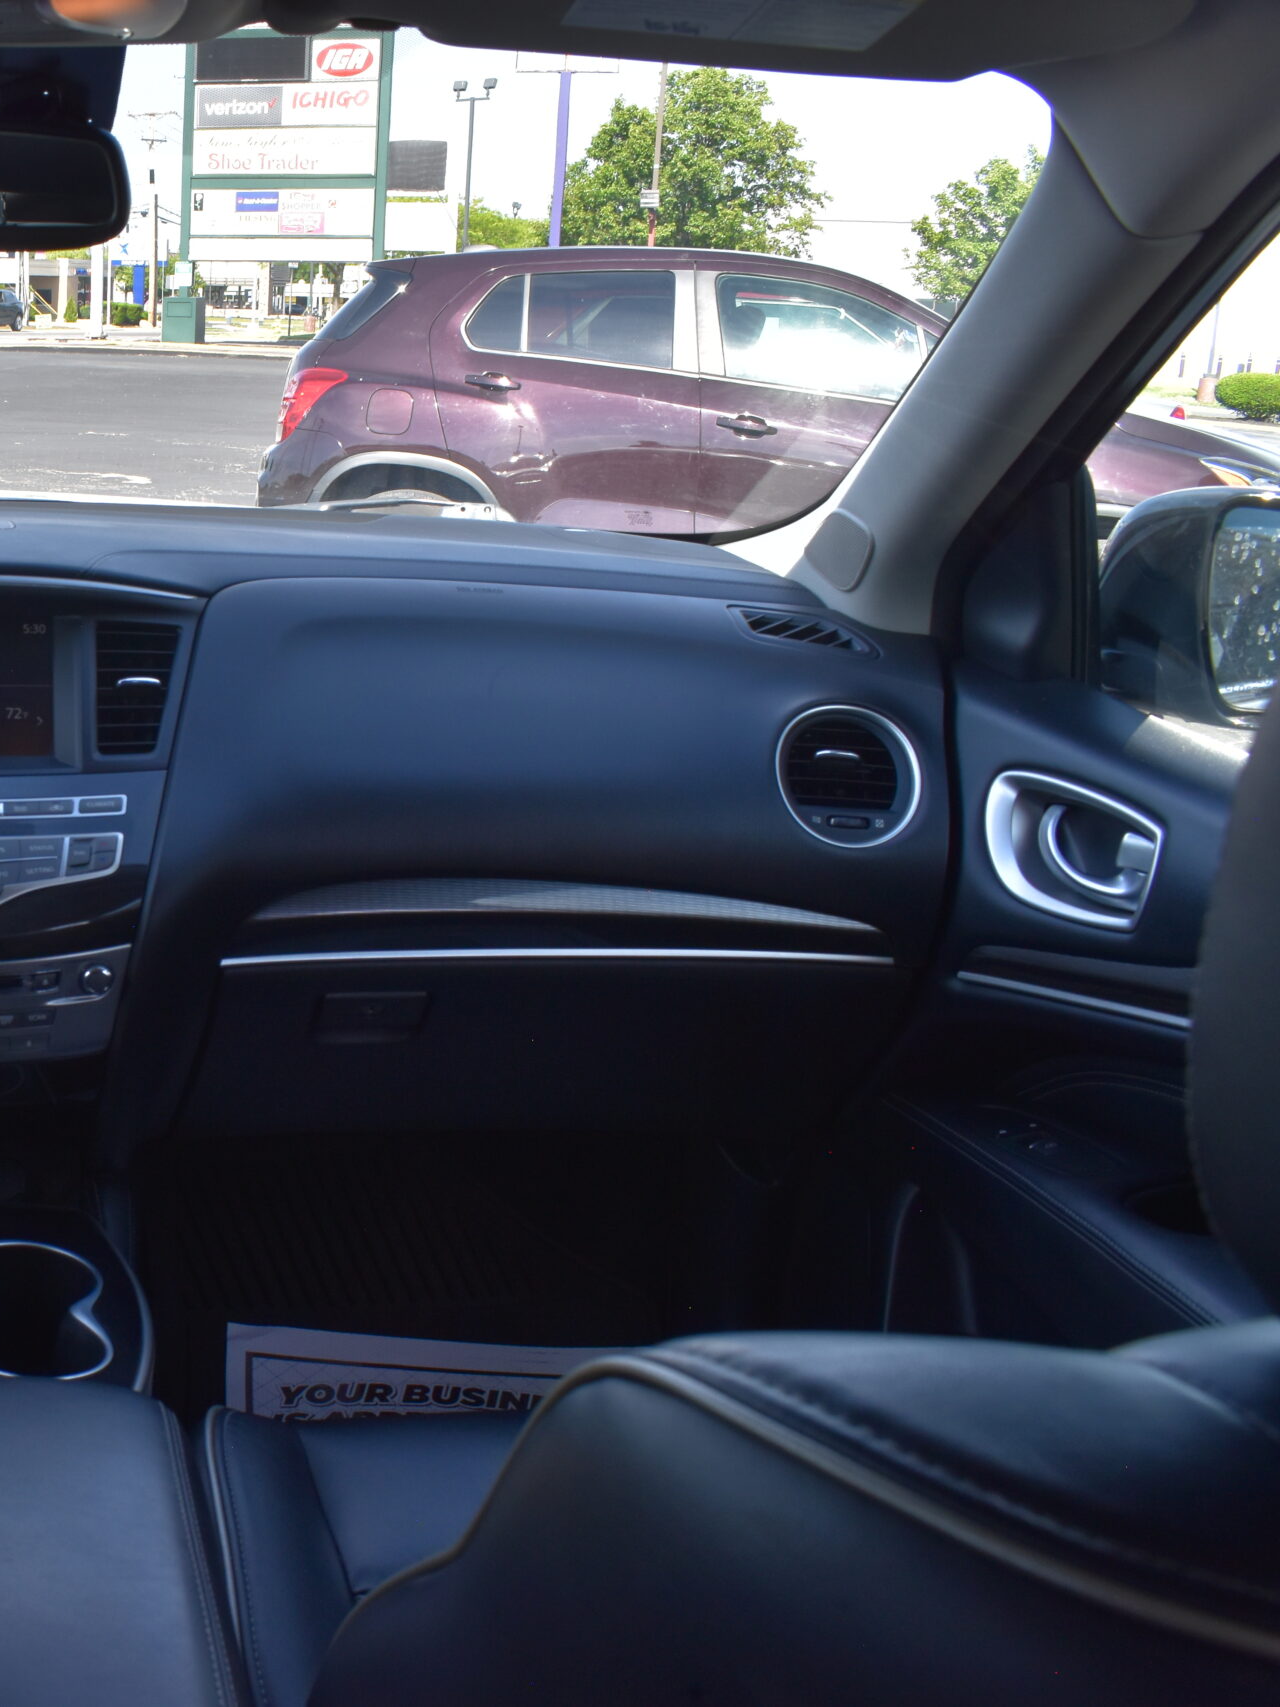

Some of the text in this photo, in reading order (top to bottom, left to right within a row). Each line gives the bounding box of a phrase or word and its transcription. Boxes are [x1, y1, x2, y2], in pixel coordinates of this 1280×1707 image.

[320, 48, 370, 70] IGA
[204, 98, 270, 116] verizon
[291, 89, 370, 109] ICHIGO
[207, 153, 320, 170] Shoe Trader
[23, 624, 46, 635] 5:30
[280, 1382, 396, 1407] YOUR
